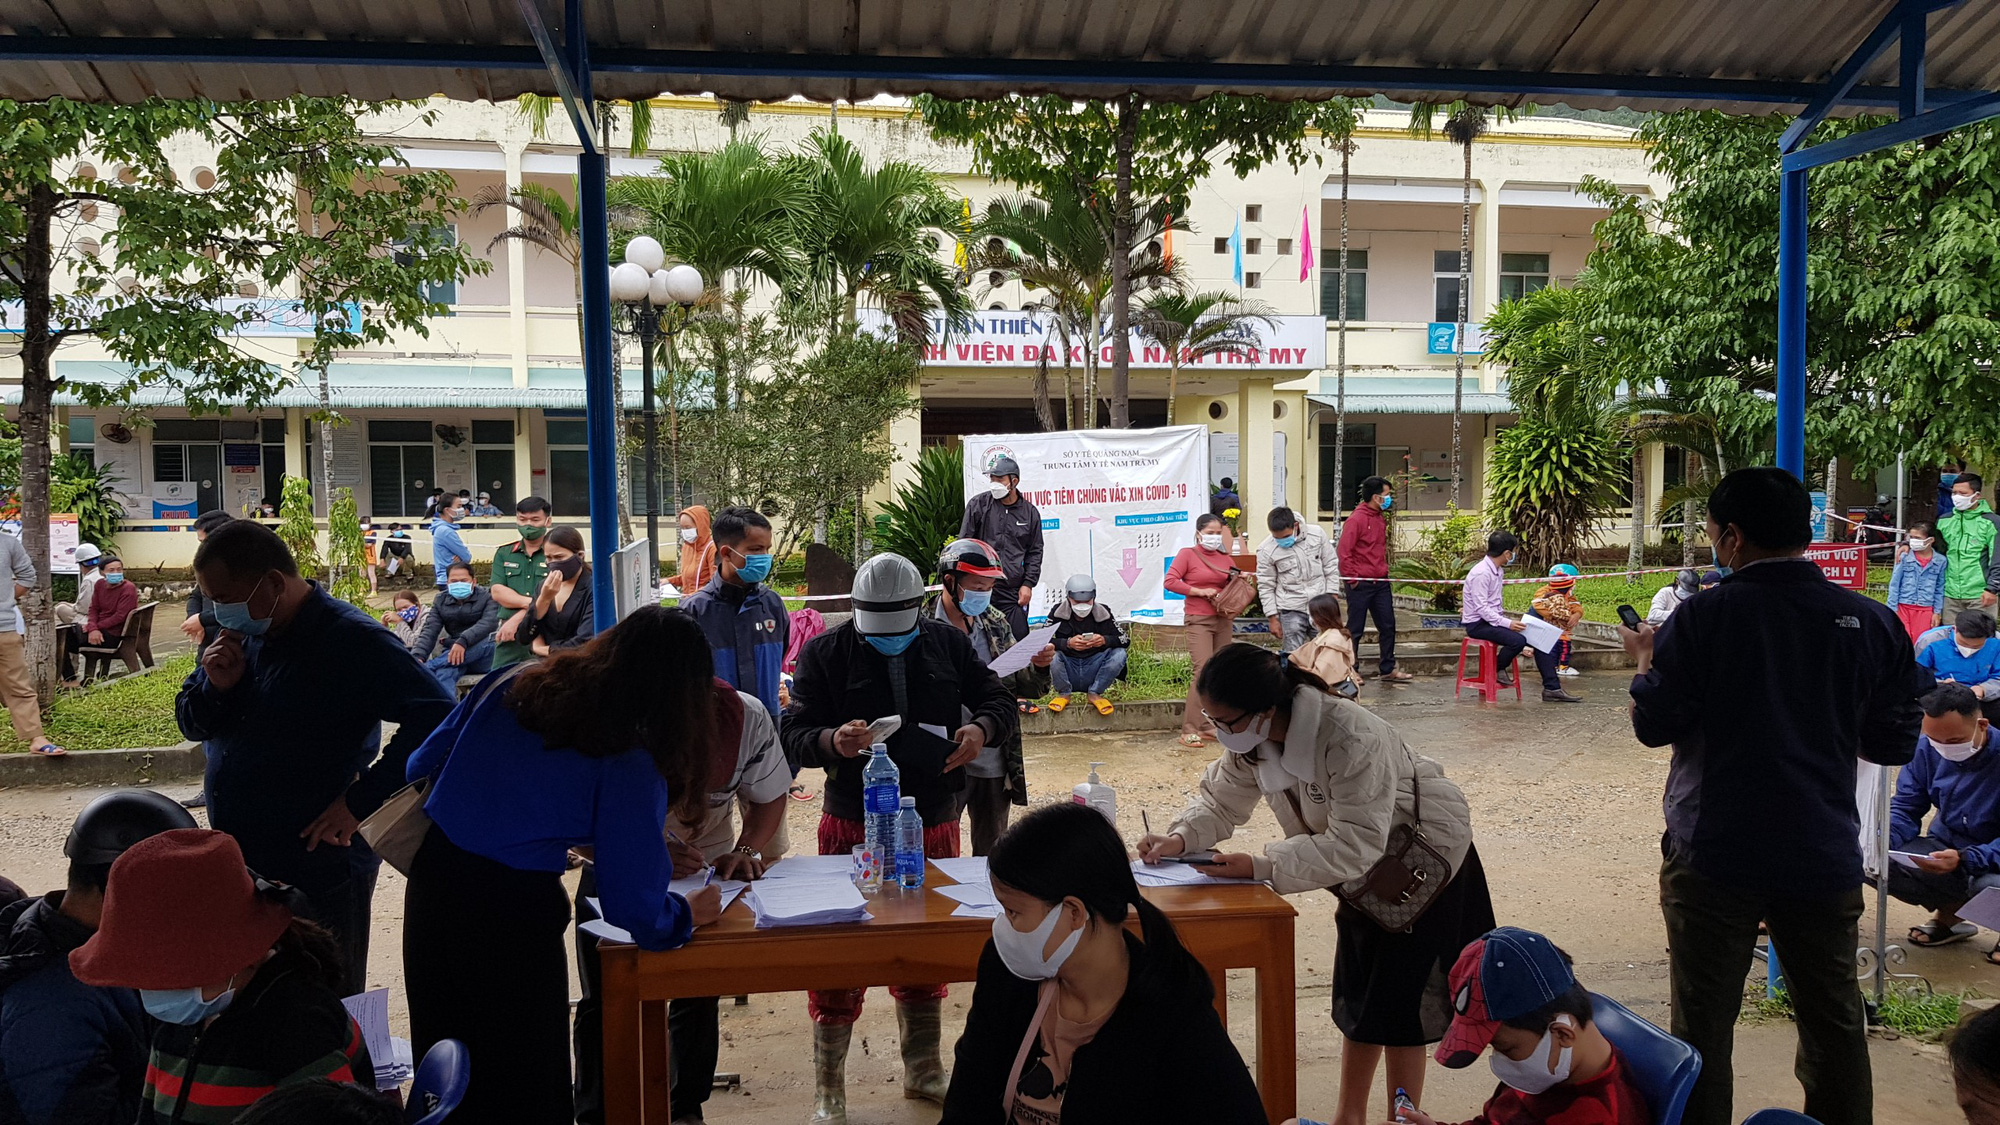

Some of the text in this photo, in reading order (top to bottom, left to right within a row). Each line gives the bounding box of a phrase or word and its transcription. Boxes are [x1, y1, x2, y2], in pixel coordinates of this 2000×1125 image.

[989, 316, 1042, 337] THIỆN
[956, 341, 1014, 363] VIỆN
[1022, 345, 1057, 362] ĐA
[1270, 348, 1307, 364] MY
[1063, 450, 1073, 458] SỞ
[1082, 449, 1091, 457] TẾ
[1093, 449, 1119, 458] QUẢNG
[1121, 449, 1140, 457] NAM
[1043, 462, 1071, 470] TRUNG
[1072, 460, 1090, 468] TÂM
[1099, 459, 1109, 467] TẾ
[1110, 460, 1128, 468] NAM
[1130, 458, 1146, 466] TRÀ
[1147, 458, 1161, 466] MY
[1035, 489, 1052, 509] VỰC
[1054, 486, 1075, 505] TIÊM
[1077, 483, 1107, 504] CHỦNG
[1109, 482, 1126, 502] VẮC
[1129, 486, 1144, 502] XIN
[1146, 485, 1170, 500] COVID
[1177, 483, 1187, 498] 19
[1804, 550, 1830, 560] KHU
[1843, 566, 1857, 577] LY
